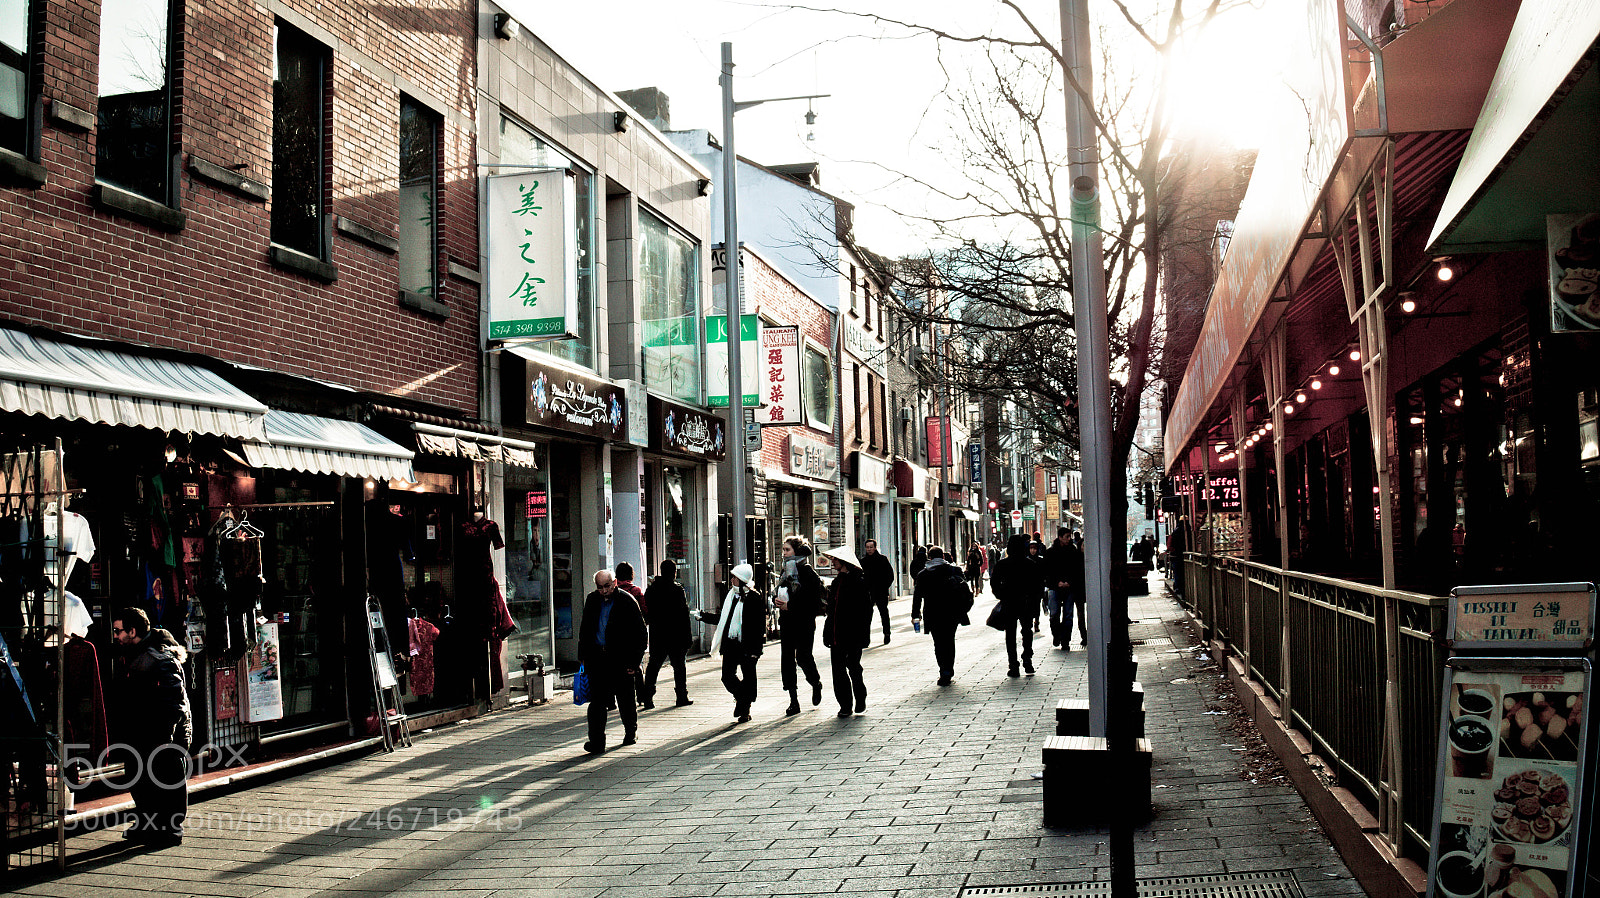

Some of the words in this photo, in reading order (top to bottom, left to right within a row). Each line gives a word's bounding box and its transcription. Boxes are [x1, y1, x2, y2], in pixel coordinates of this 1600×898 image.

[492, 325, 511, 336] 514
[513, 323, 533, 334] 398
[536, 321, 561, 333] 9398
[1205, 477, 1238, 487] uffet
[1201, 487, 1239, 500] 12.75
[1464, 601, 1518, 615] DESSERT
[1532, 602, 1561, 618] 台灣
[1491, 615, 1508, 627] DE
[1552, 619, 1581, 636] 甜品
[1483, 628, 1538, 640] TAIWAN
